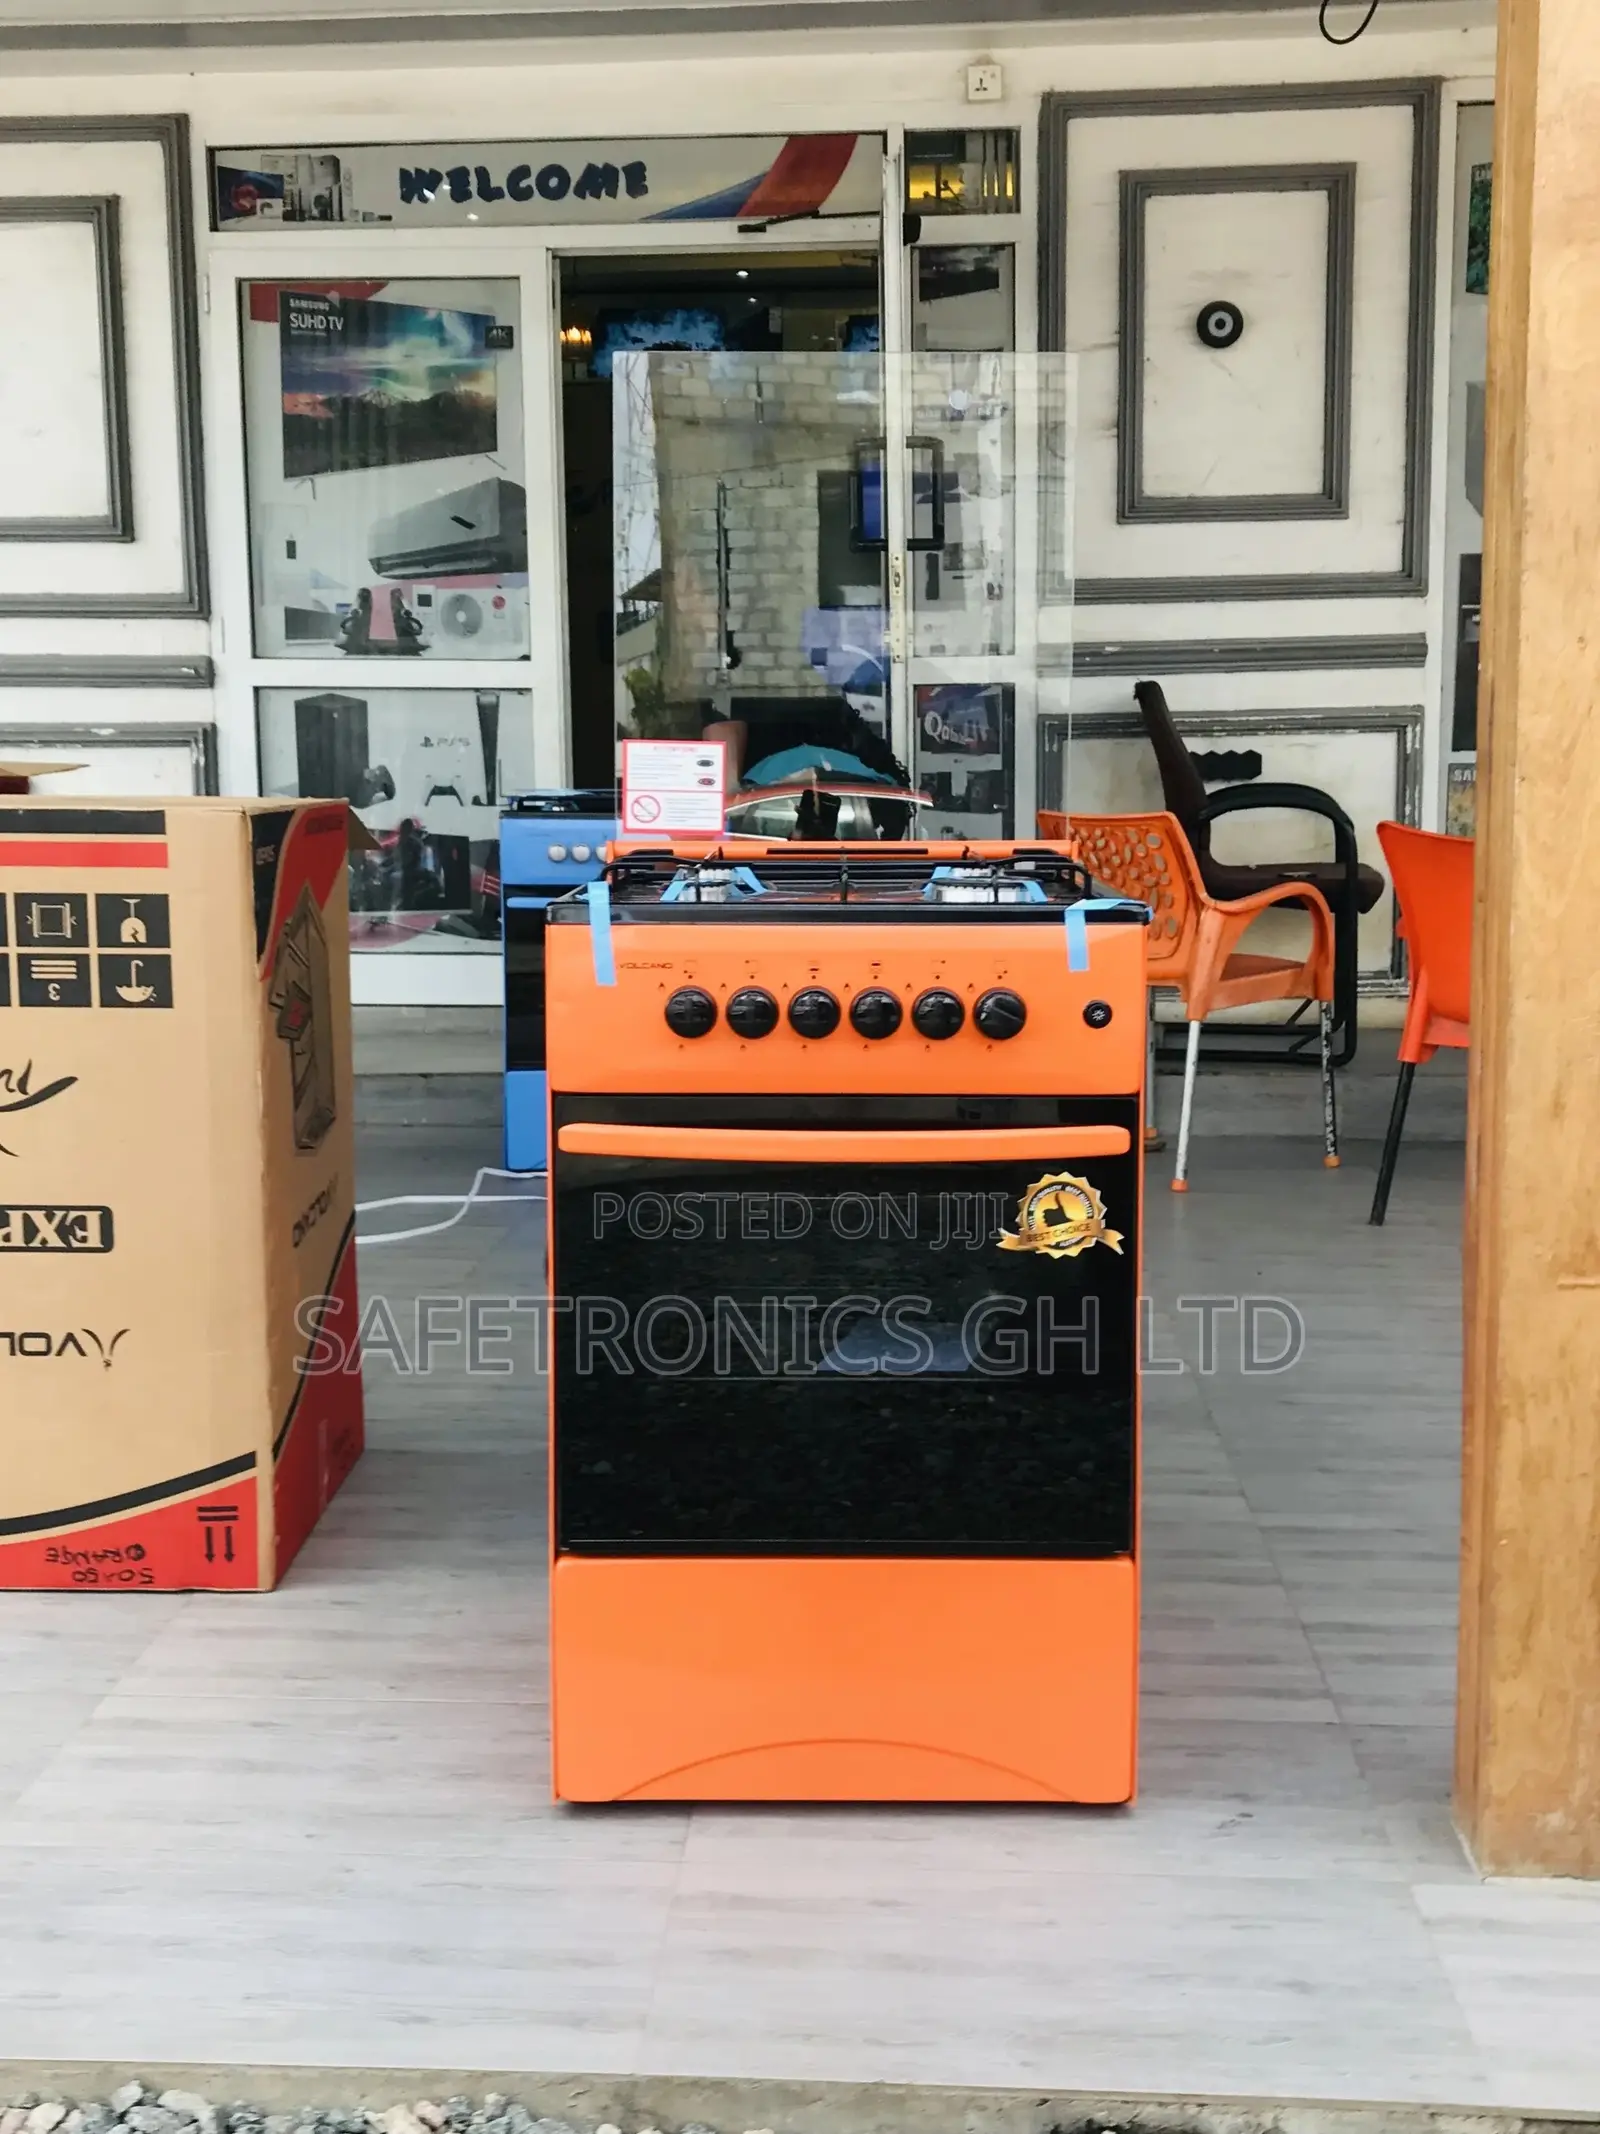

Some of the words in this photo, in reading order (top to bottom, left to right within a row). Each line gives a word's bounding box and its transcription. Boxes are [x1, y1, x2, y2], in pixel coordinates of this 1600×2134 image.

[399, 160, 649, 204] WELCOME
[290, 298, 329, 311] SAMSUNG
[290, 312, 327, 329] SUHD
[328, 315, 344, 330] TV
[437, 736, 470, 748] PS5
[619, 962, 673, 970] VOLCANO
[48, 983, 60, 1001] 3
[1026, 1230, 1052, 1243] BEST
[1052, 1222, 1092, 1238] CHOICE
